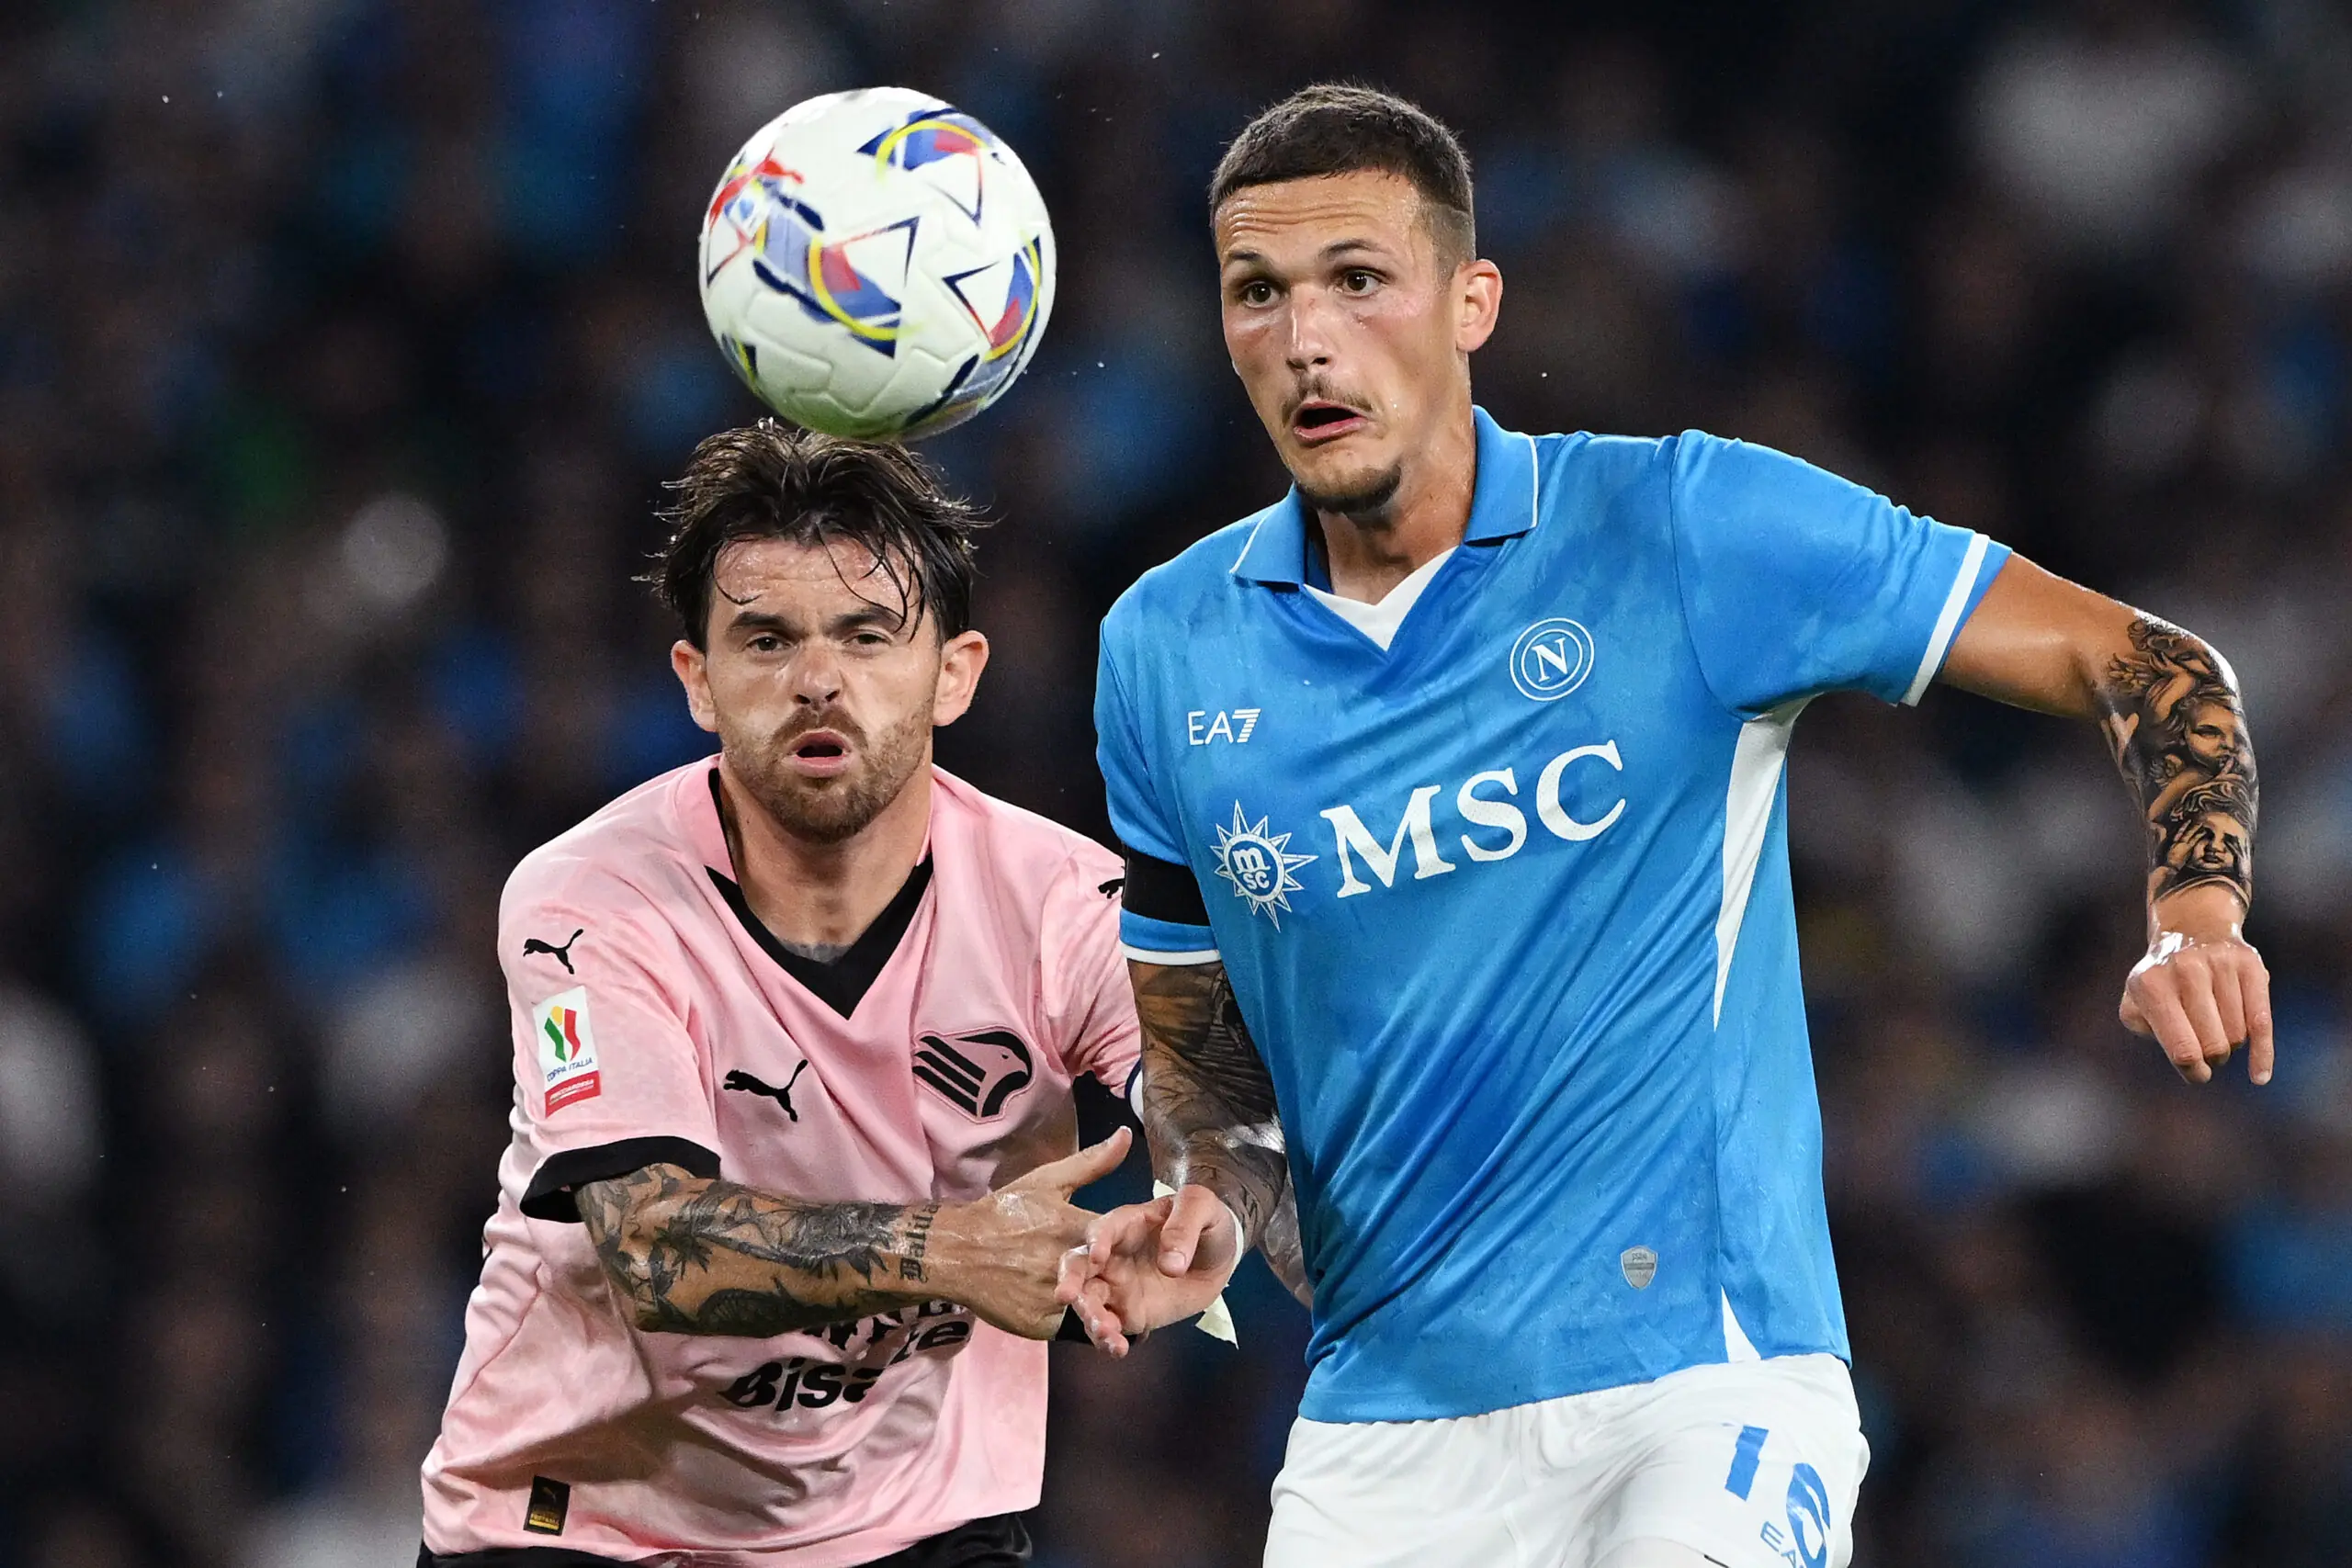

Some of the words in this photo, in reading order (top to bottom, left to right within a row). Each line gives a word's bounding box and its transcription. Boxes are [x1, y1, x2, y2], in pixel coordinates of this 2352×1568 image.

[1531, 637, 1568, 682] N
[1187, 708, 1261, 746] EA7
[1319, 739, 1627, 899] MSC
[569, 1057, 594, 1071] ITALIA
[1759, 1520, 1807, 1568] EA
